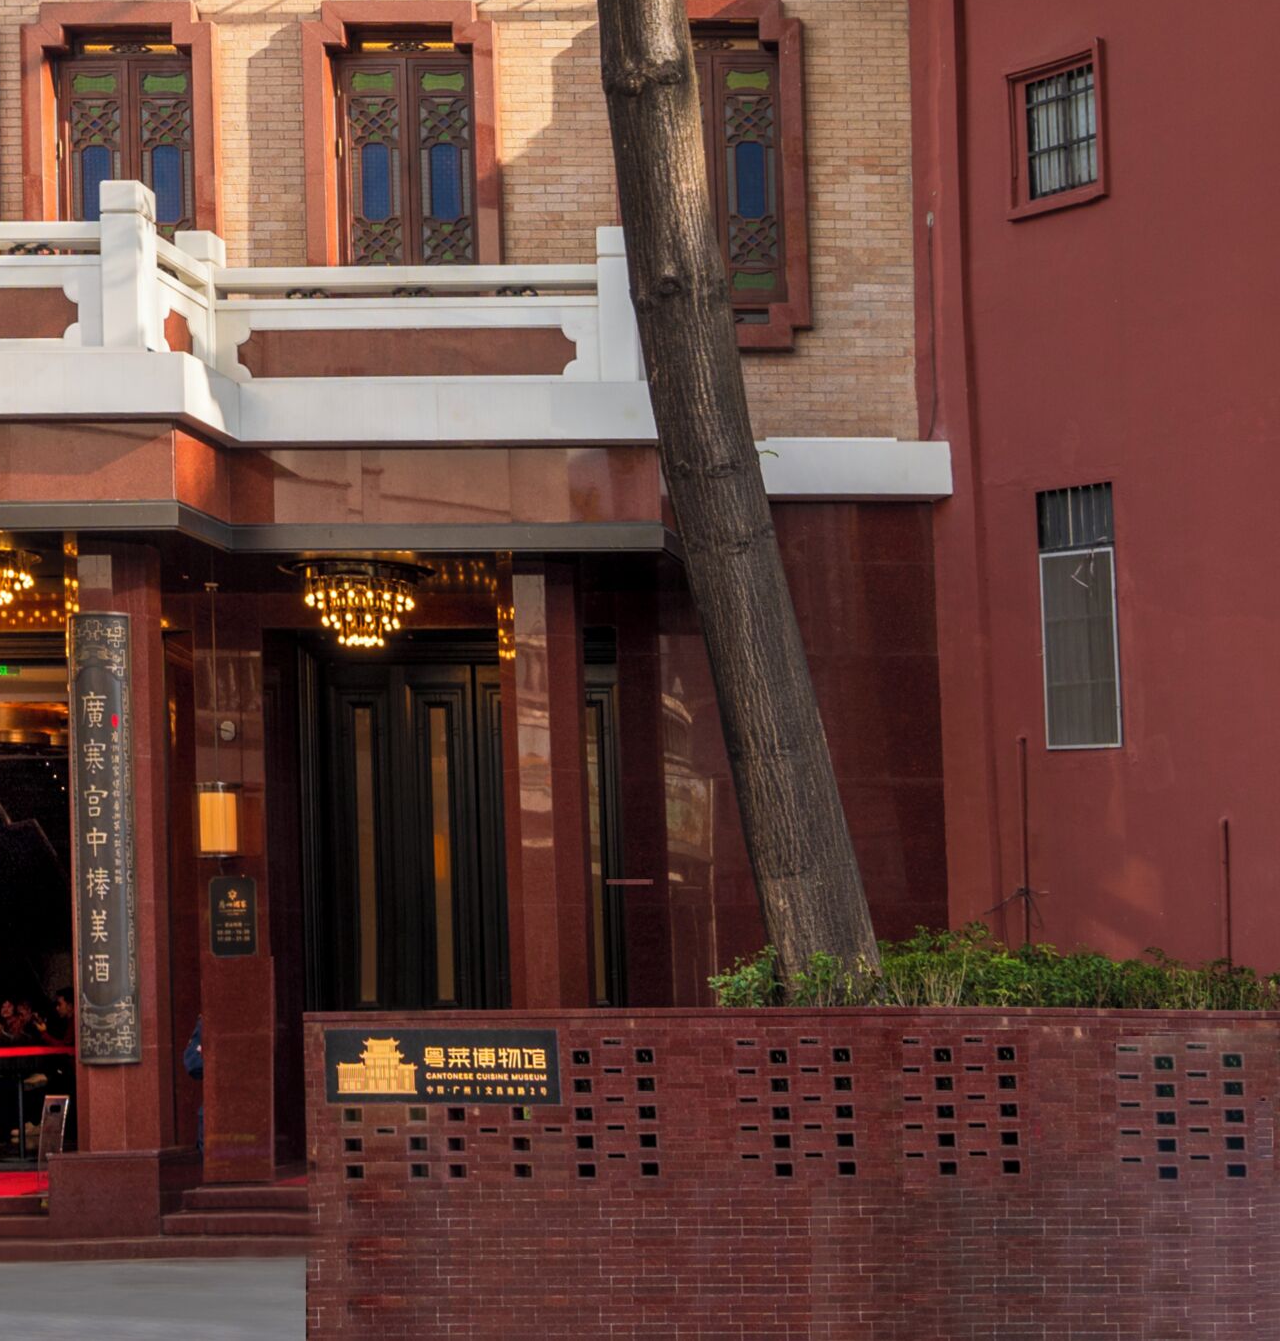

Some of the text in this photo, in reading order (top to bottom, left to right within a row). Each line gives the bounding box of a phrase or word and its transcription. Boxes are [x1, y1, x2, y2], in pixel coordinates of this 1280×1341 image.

[423, 1046, 547, 1069] 粤菜博物馆
[425, 1072, 548, 1082] CANTONESE CUISINE MUSEUM
